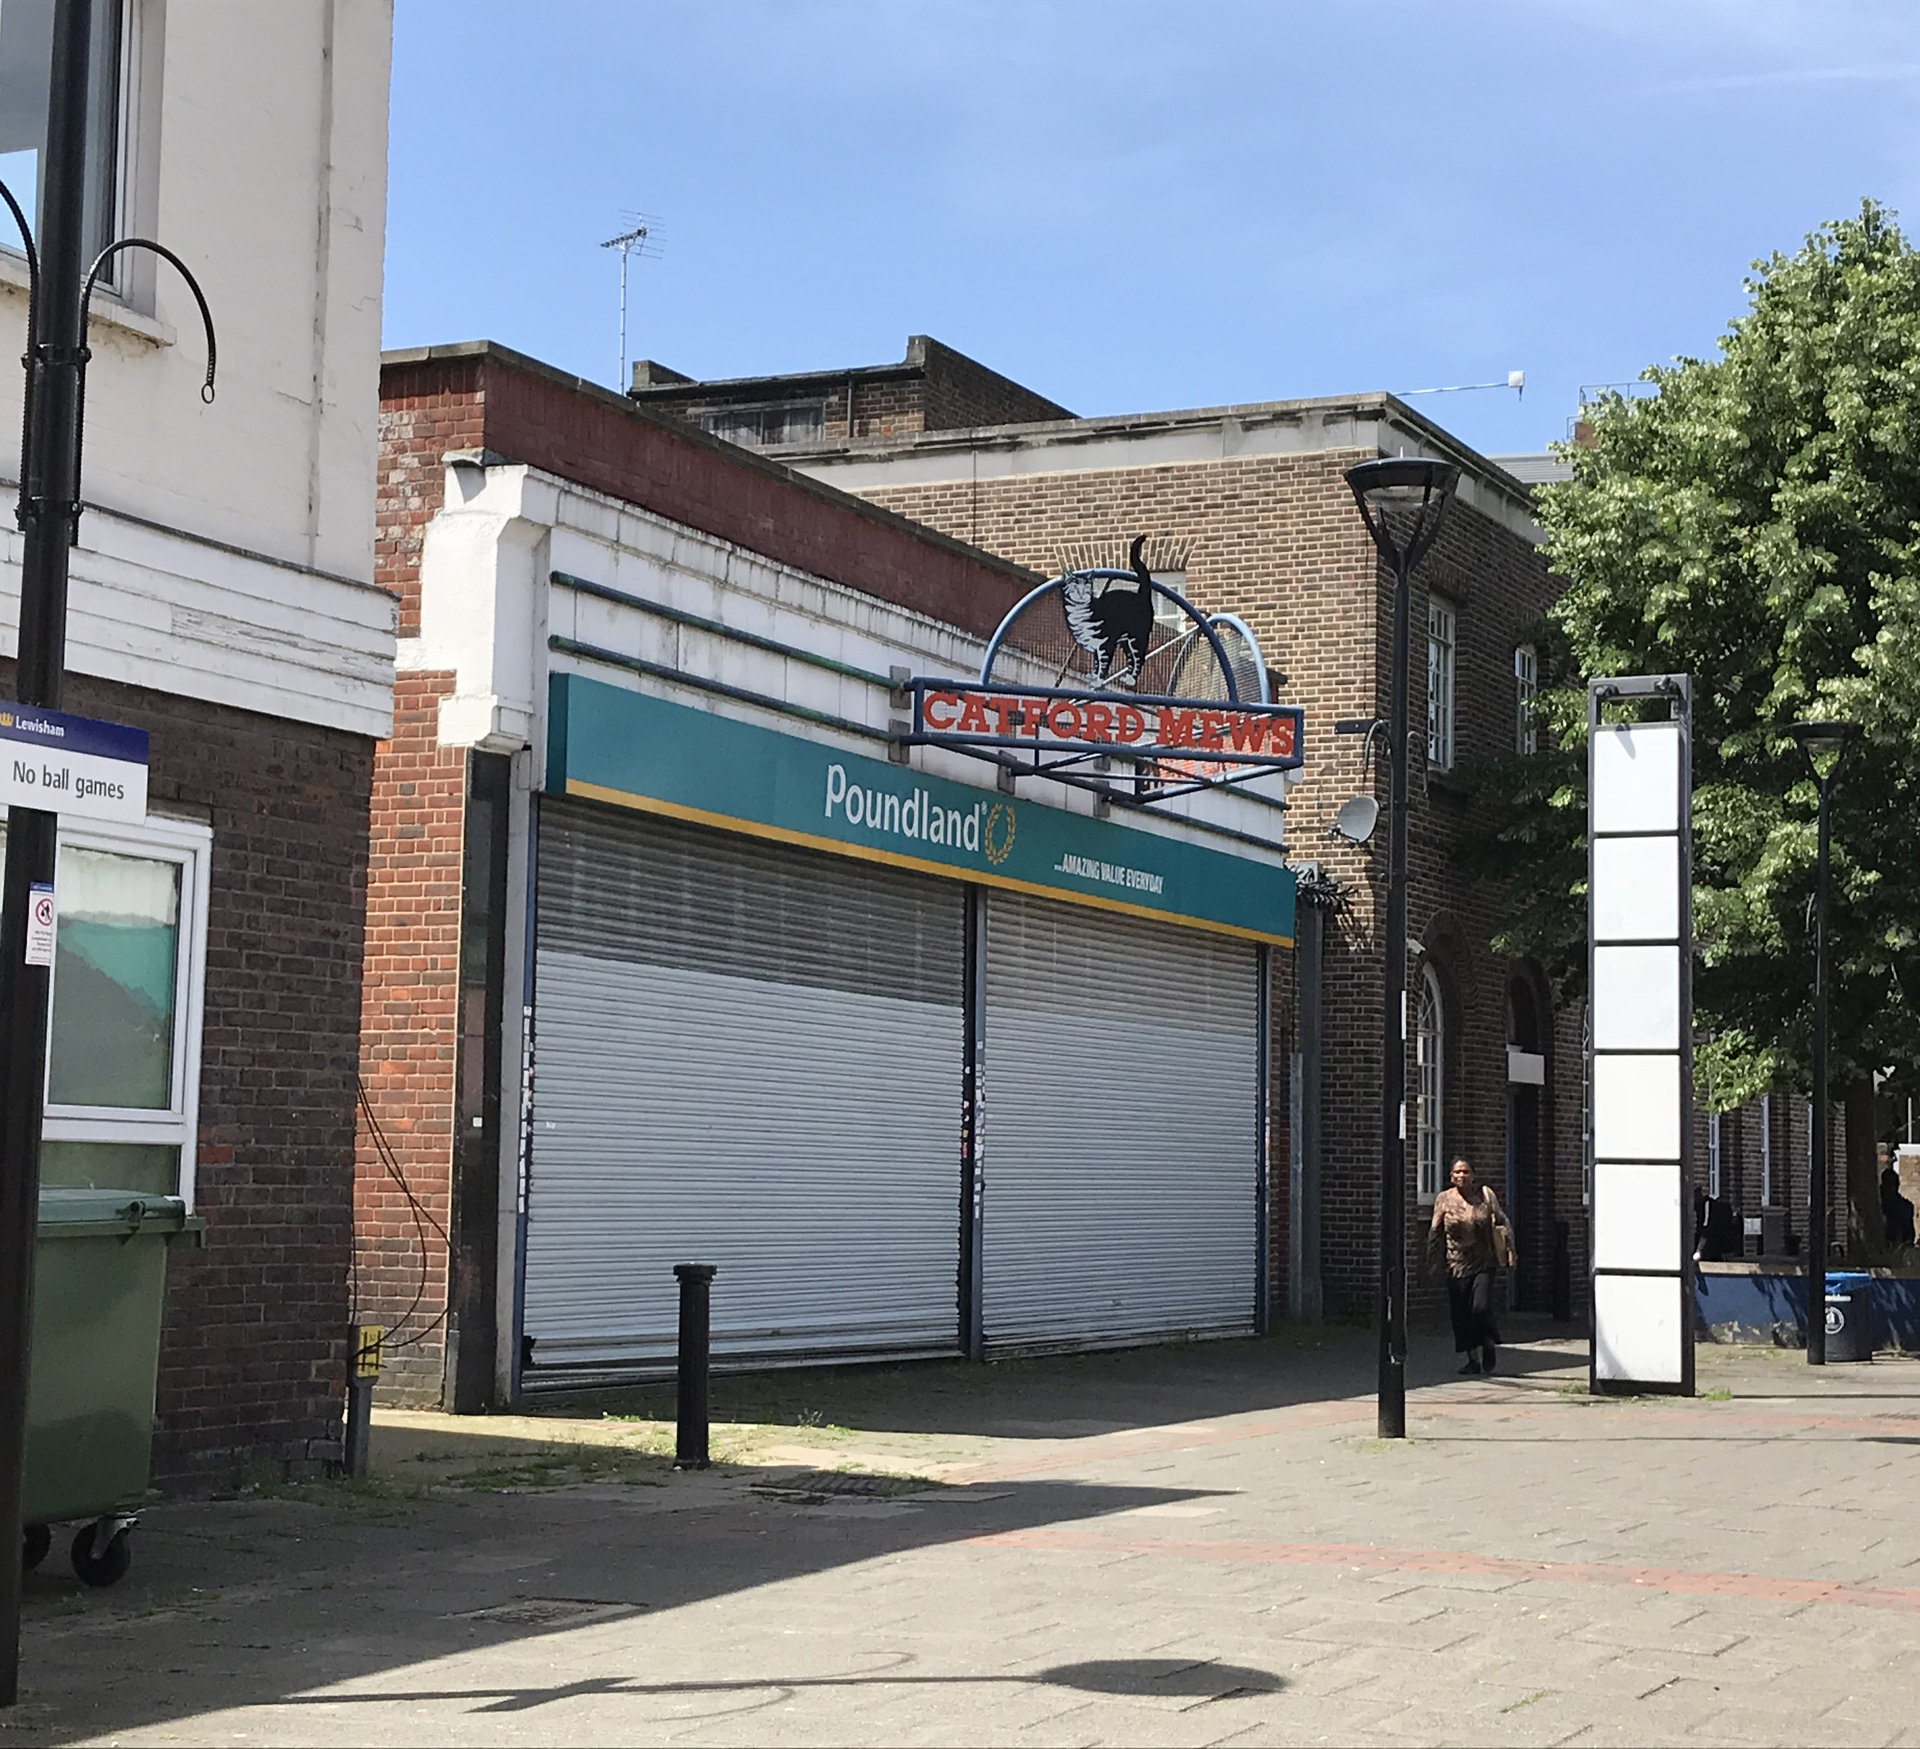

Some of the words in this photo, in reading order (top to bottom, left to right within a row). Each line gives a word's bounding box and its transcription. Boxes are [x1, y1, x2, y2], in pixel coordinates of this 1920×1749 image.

[15, 714, 65, 738] Lewisham
[922, 690, 1144, 744] CATFORD
[1154, 706, 1296, 756] MEWS
[12, 760, 36, 785] No
[42, 765, 69, 791] ball
[75, 777, 125, 800] games
[1101, 862, 1125, 886] VALUE
[1126, 868, 1164, 894] EVERYDAY
